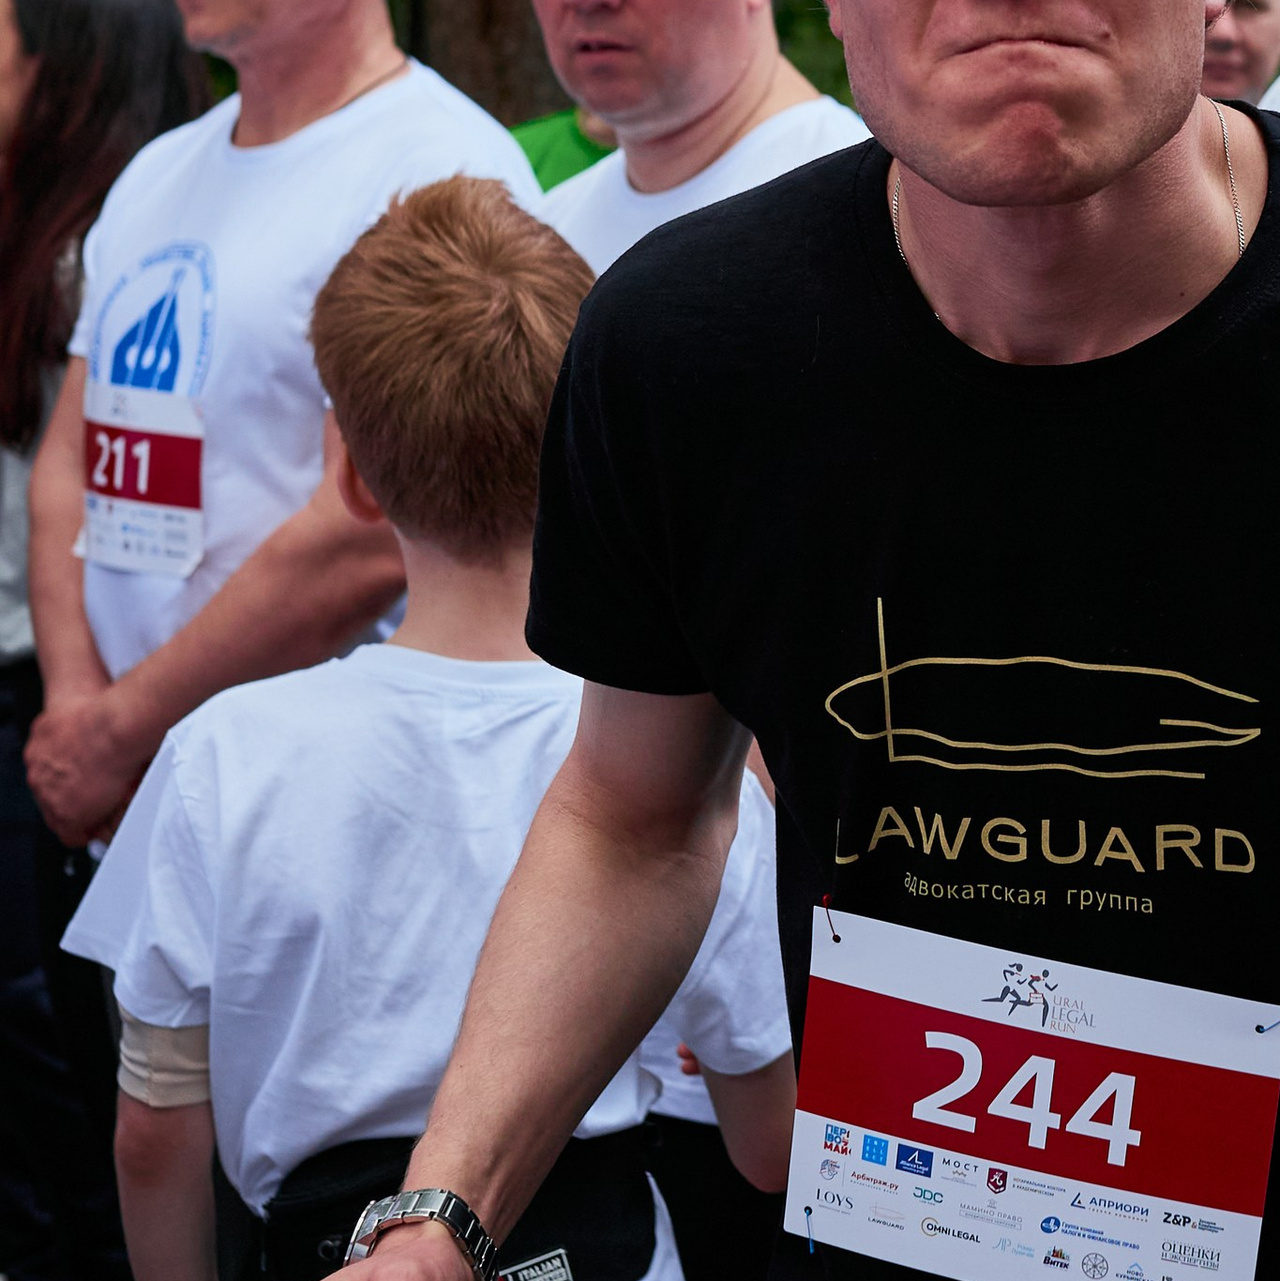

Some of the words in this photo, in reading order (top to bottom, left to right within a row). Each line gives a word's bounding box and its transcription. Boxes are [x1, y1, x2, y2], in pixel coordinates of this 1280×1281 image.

[93, 431, 150, 495] 211
[835, 806, 1256, 873] LAWGUARD
[904, 871, 1046, 906] адвокатская
[1067, 888, 1153, 913] группа
[1053, 995, 1085, 1010] URAL
[1050, 1020, 1077, 1034] RUN
[1051, 1006, 1097, 1028] LEGAL
[911, 1030, 1141, 1167] 244
[942, 1157, 978, 1173] МОСТ
[851, 1170, 900, 1191] Арбитраж.ру
[816, 1188, 854, 1210] LOYS
[913, 1186, 944, 1204] JDC
[1089, 1197, 1149, 1216] АПРИОРИ
[1162, 1211, 1191, 1227] Z&P
[926, 1223, 951, 1236] OMNI
[952, 1229, 981, 1244] LEGAL
[1161, 1241, 1221, 1262] ОЦЕНКИ
